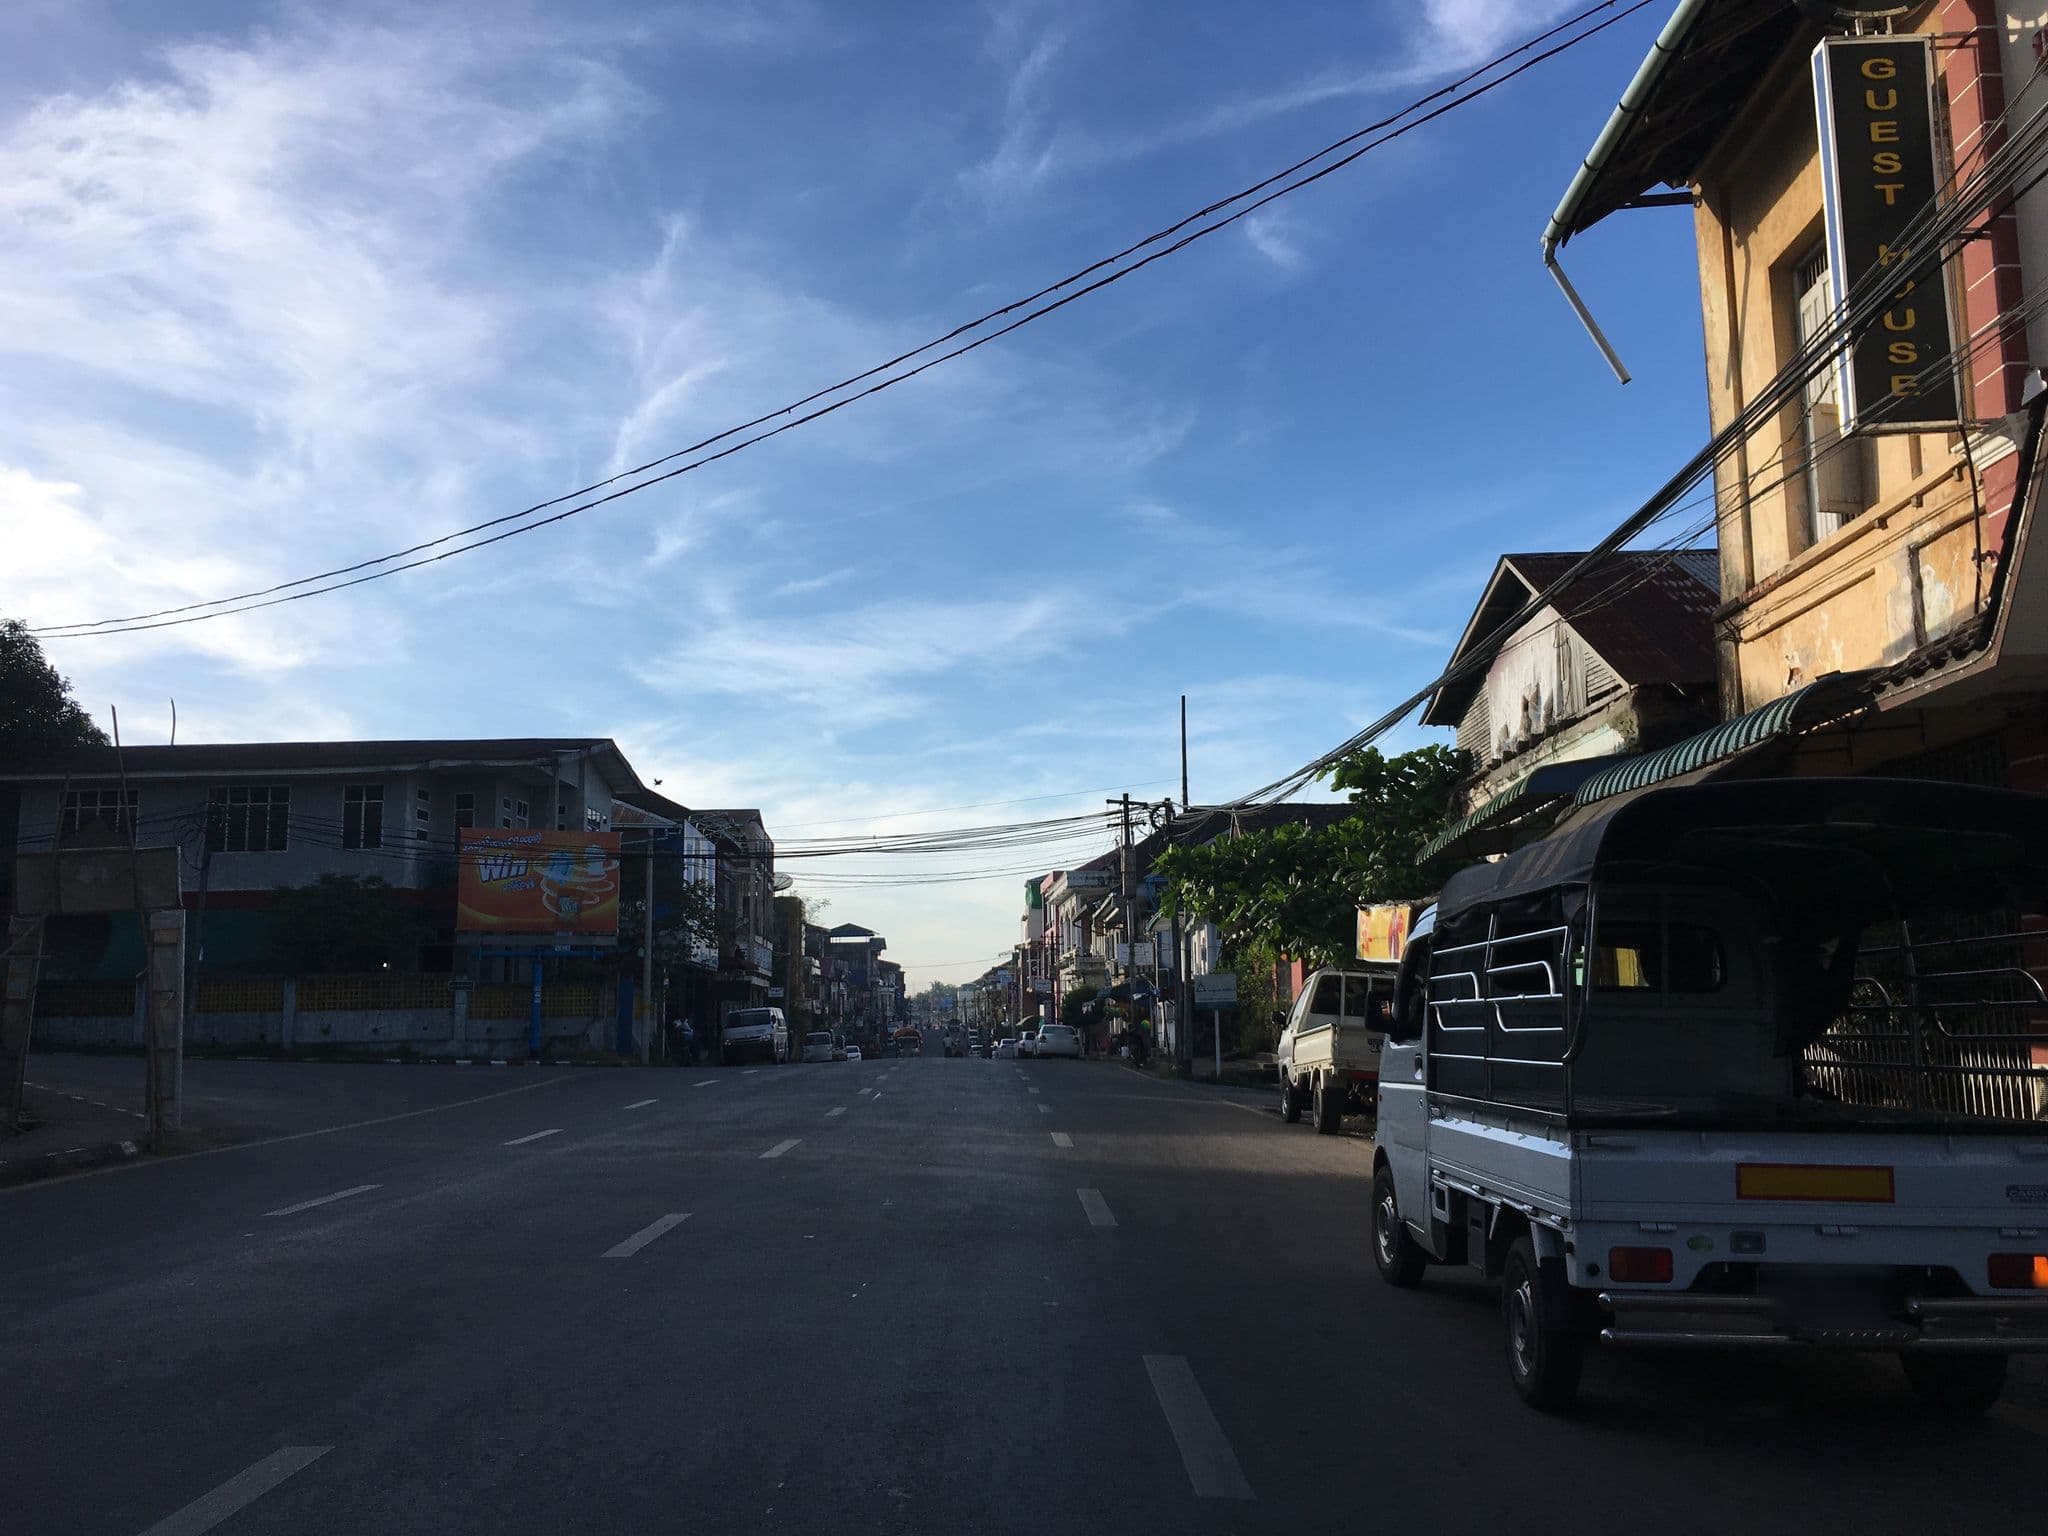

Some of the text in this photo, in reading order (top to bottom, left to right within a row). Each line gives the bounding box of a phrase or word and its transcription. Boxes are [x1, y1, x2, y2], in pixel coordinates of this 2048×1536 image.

[1862, 58, 1921, 397] GUEST HUSE
[478, 853, 528, 883] Win
